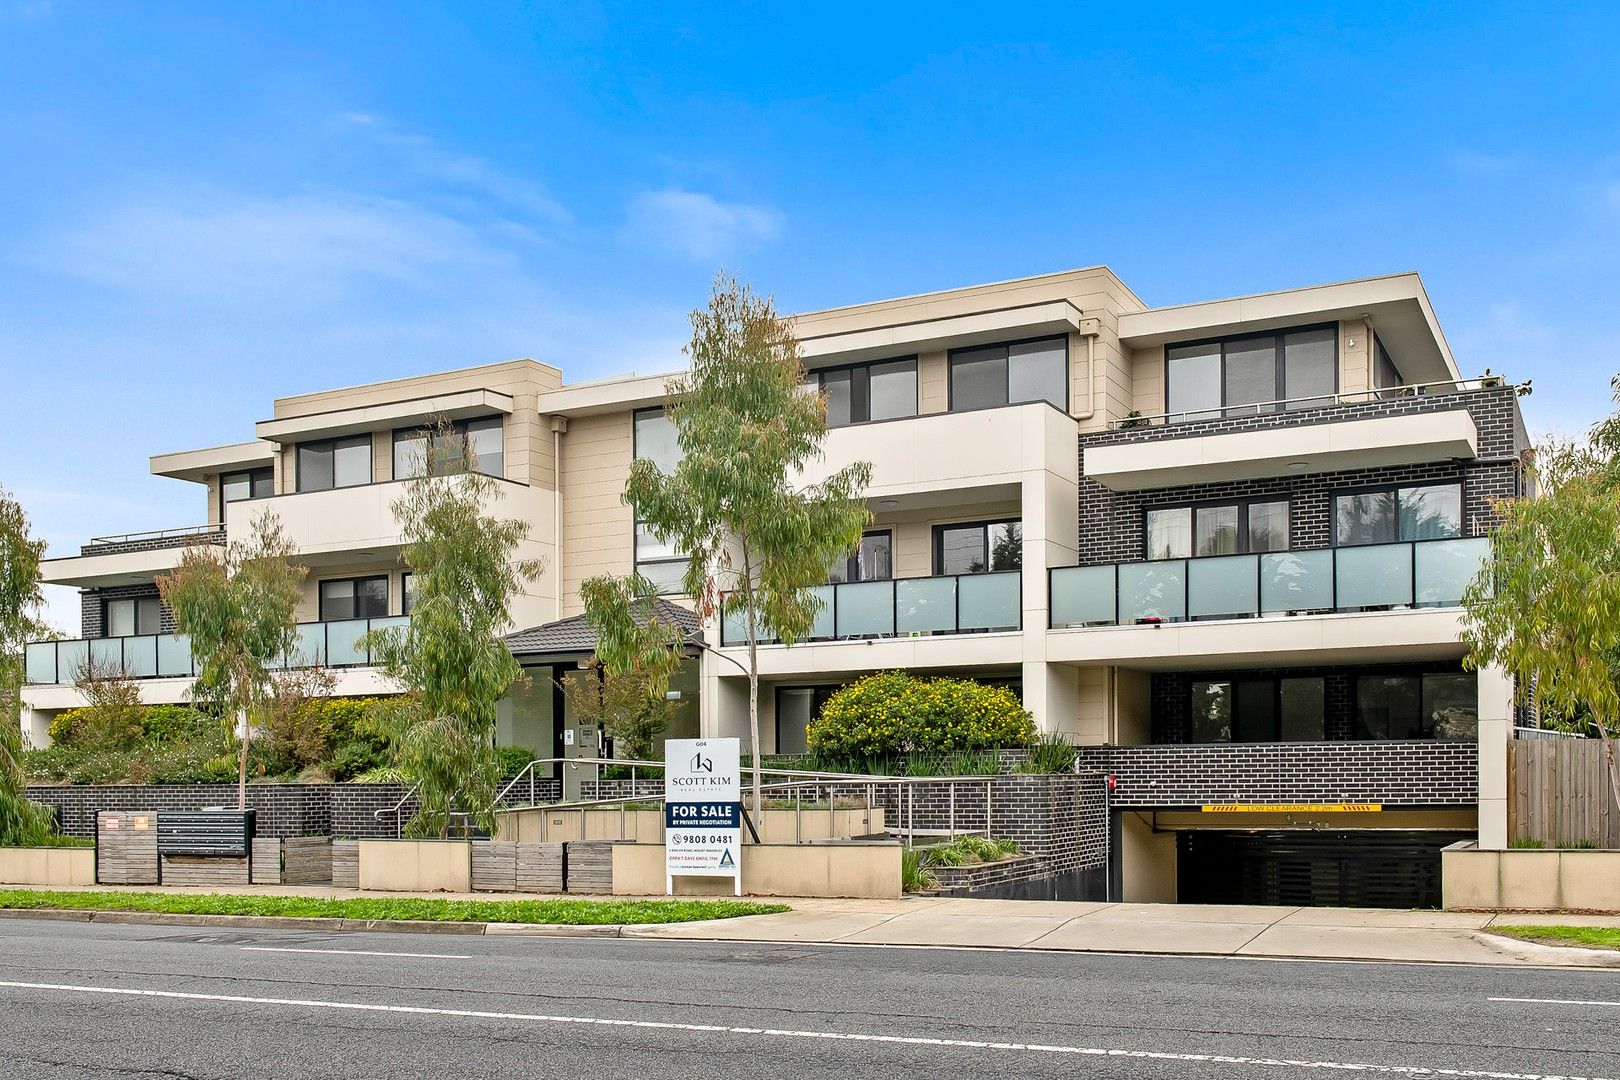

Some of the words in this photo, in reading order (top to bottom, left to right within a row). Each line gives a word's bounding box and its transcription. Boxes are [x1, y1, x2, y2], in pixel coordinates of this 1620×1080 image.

[672, 777, 707, 786] SCOTT
[710, 776, 731, 785] KIM
[672, 805, 698, 817] FOR
[701, 805, 732, 817] SALE
[683, 835, 707, 844] 9808
[710, 835, 732, 844] 0481
